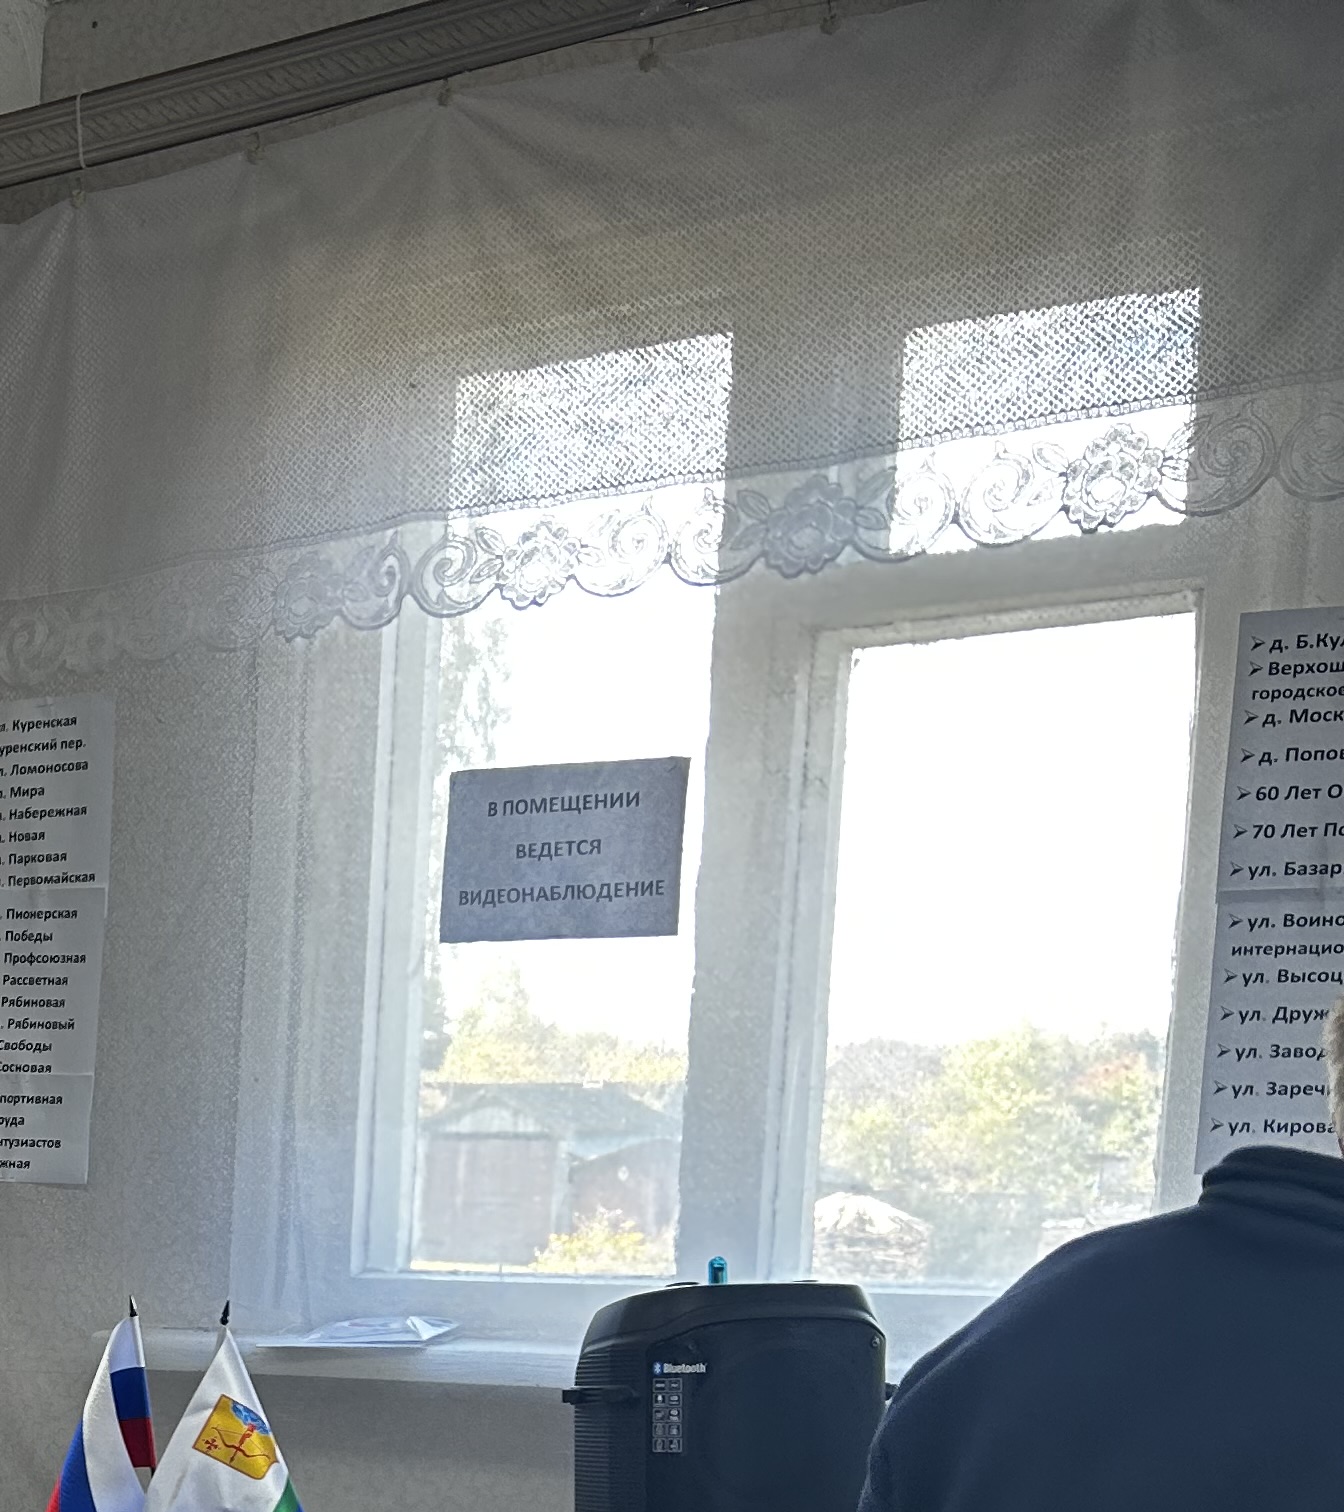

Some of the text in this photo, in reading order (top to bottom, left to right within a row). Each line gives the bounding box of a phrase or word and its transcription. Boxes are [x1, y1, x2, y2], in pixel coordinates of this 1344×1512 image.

[1269, 633, 1344, 653] д. Б.Ку
[12, 716, 77, 733] Куренская
[1262, 713, 1282, 727] д.
[61, 738, 86, 750] пер.
[1259, 751, 1278, 766] д.
[10, 761, 89, 776] Ломоносова
[10, 786, 45, 799] Мира
[1256, 786, 1279, 801] 60
[1284, 785, 1321, 801] Лет
[488, 792, 640, 817] В ПОМЕЩЕНИИ
[9, 806, 88, 820] Набережная
[9, 831, 45, 844] Новая
[1252, 824, 1275, 839] 70
[1281, 824, 1318, 839] Лет
[516, 839, 602, 861] ВЕДЕТСЯ
[8, 853, 67, 866] Парковая
[1248, 861, 1344, 880] ул. Базар
[8, 873, 95, 889] Первомайская
[459, 880, 665, 908] ВИДЕОНАБЛЮДЕНИЕ
[7, 909, 78, 922] Пионерская
[1247, 918, 1275, 932] ул.
[5, 930, 53, 943] Победы
[4, 952, 86, 966] Профсоюзная
[2, 975, 69, 986] Рассветная
[1242, 972, 1270, 987] ул.
[1, 997, 65, 1009] Рябиновая
[7, 1018, 75, 1030] Рябиновый
[1238, 1010, 1266, 1025] ул.
[1235, 1047, 1263, 1062] ул.
[1231, 1082, 1330, 1099] ул. Зареч
[1228, 1121, 1256, 1136] ул.
[663, 1363, 706, 1373] Bluetooth
